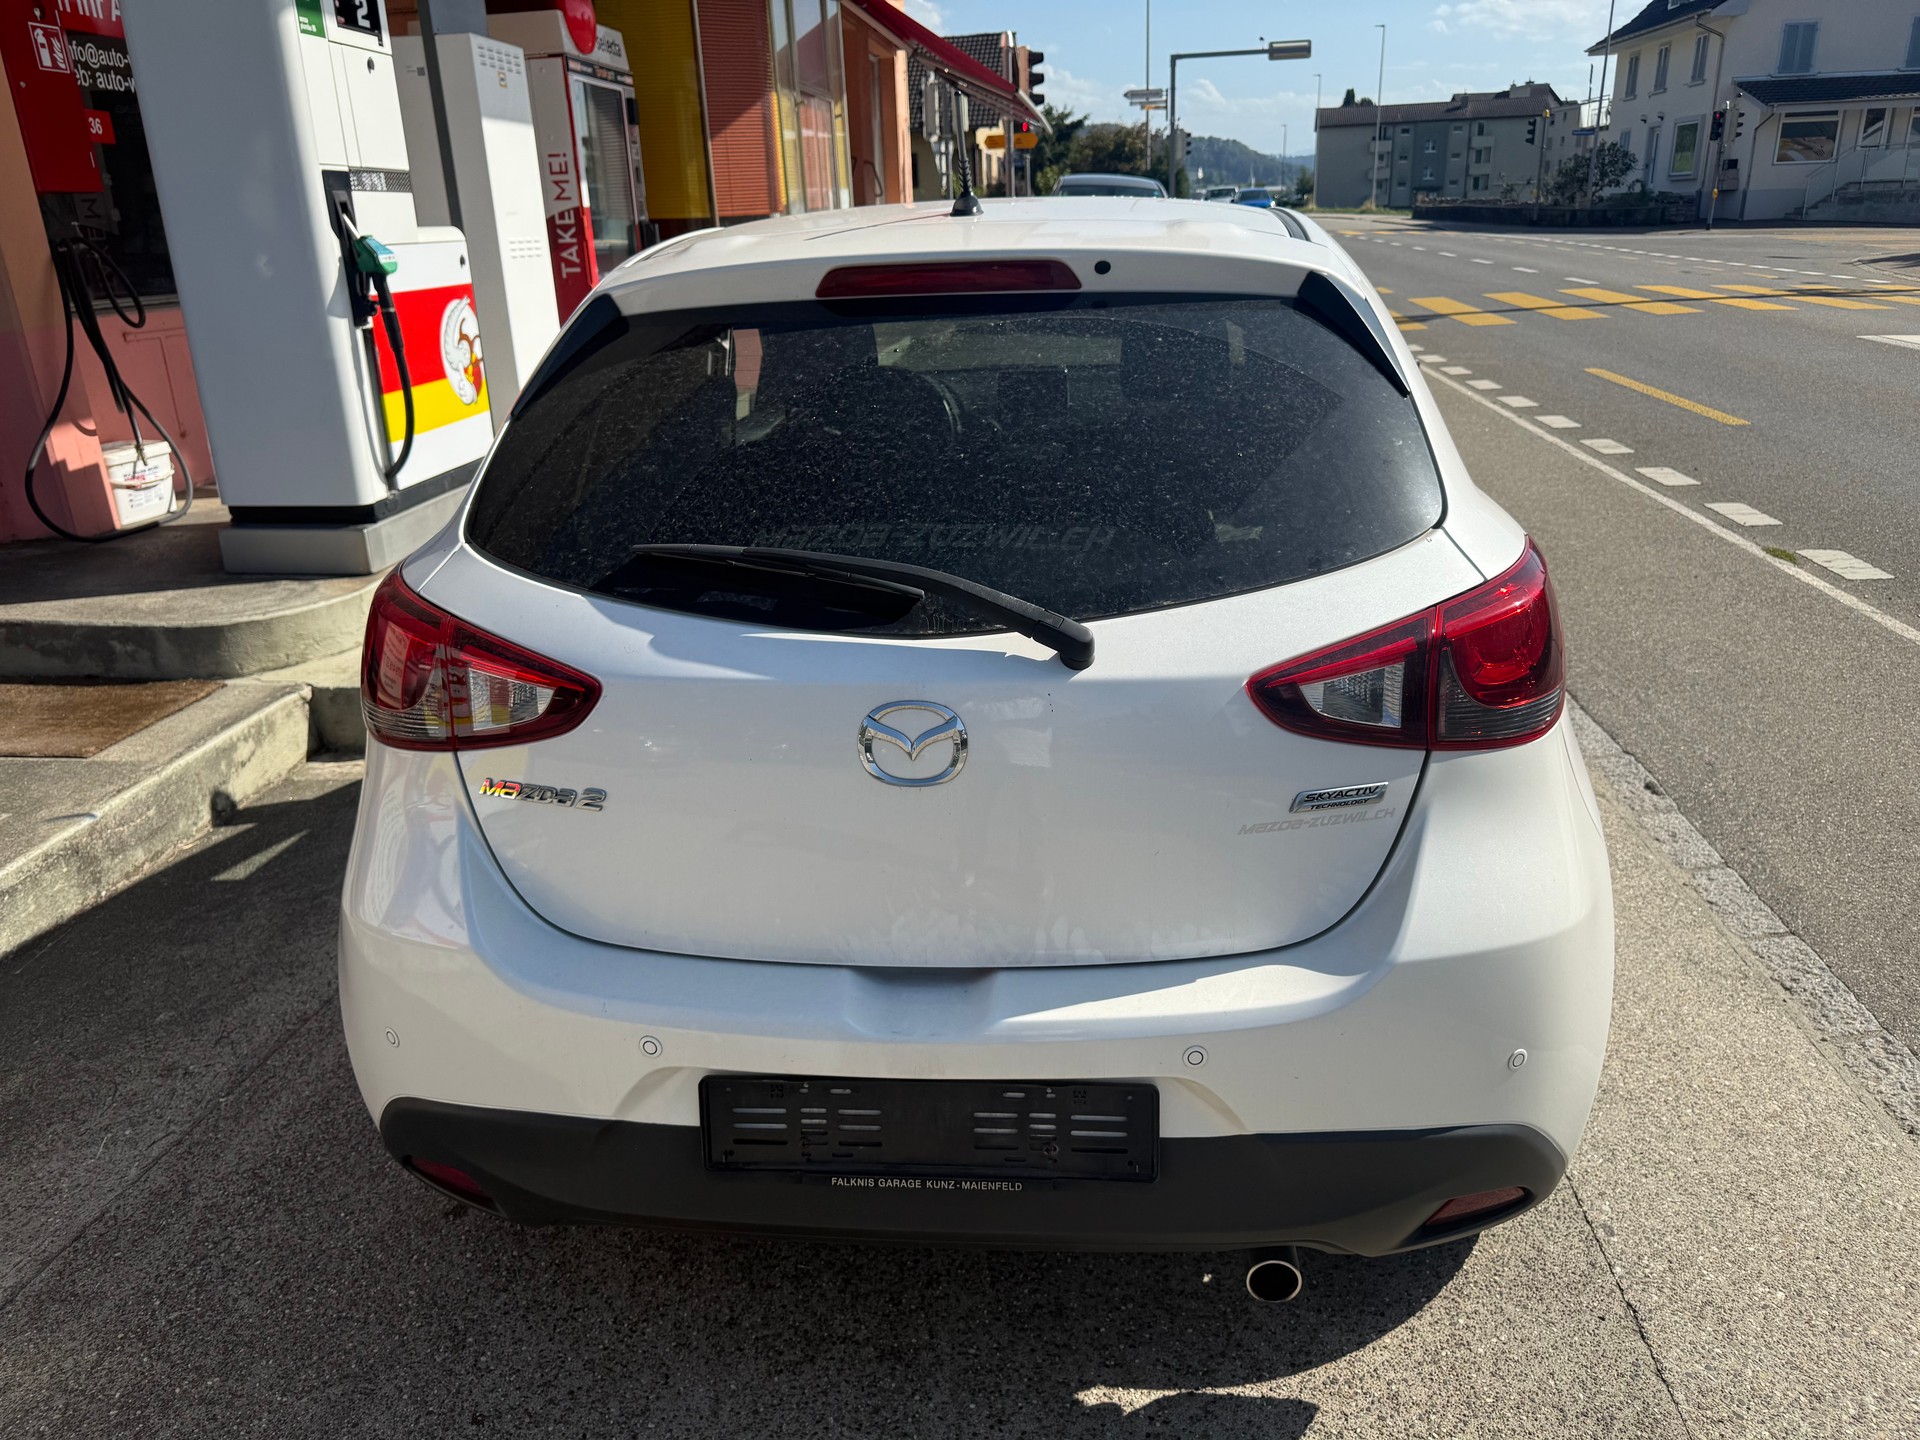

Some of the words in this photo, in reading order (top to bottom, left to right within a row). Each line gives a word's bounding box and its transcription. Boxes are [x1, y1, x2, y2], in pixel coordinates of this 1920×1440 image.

[88, 117, 103, 134] 36
[547, 152, 572, 201] ME!
[555, 209, 581, 279] TAKE
[1304, 785, 1380, 802] SKYACTIV
[1310, 798, 1371, 810] TECHNOLOGY
[831, 1177, 875, 1188] FALKNIS
[878, 1178, 922, 1189] GARAGE
